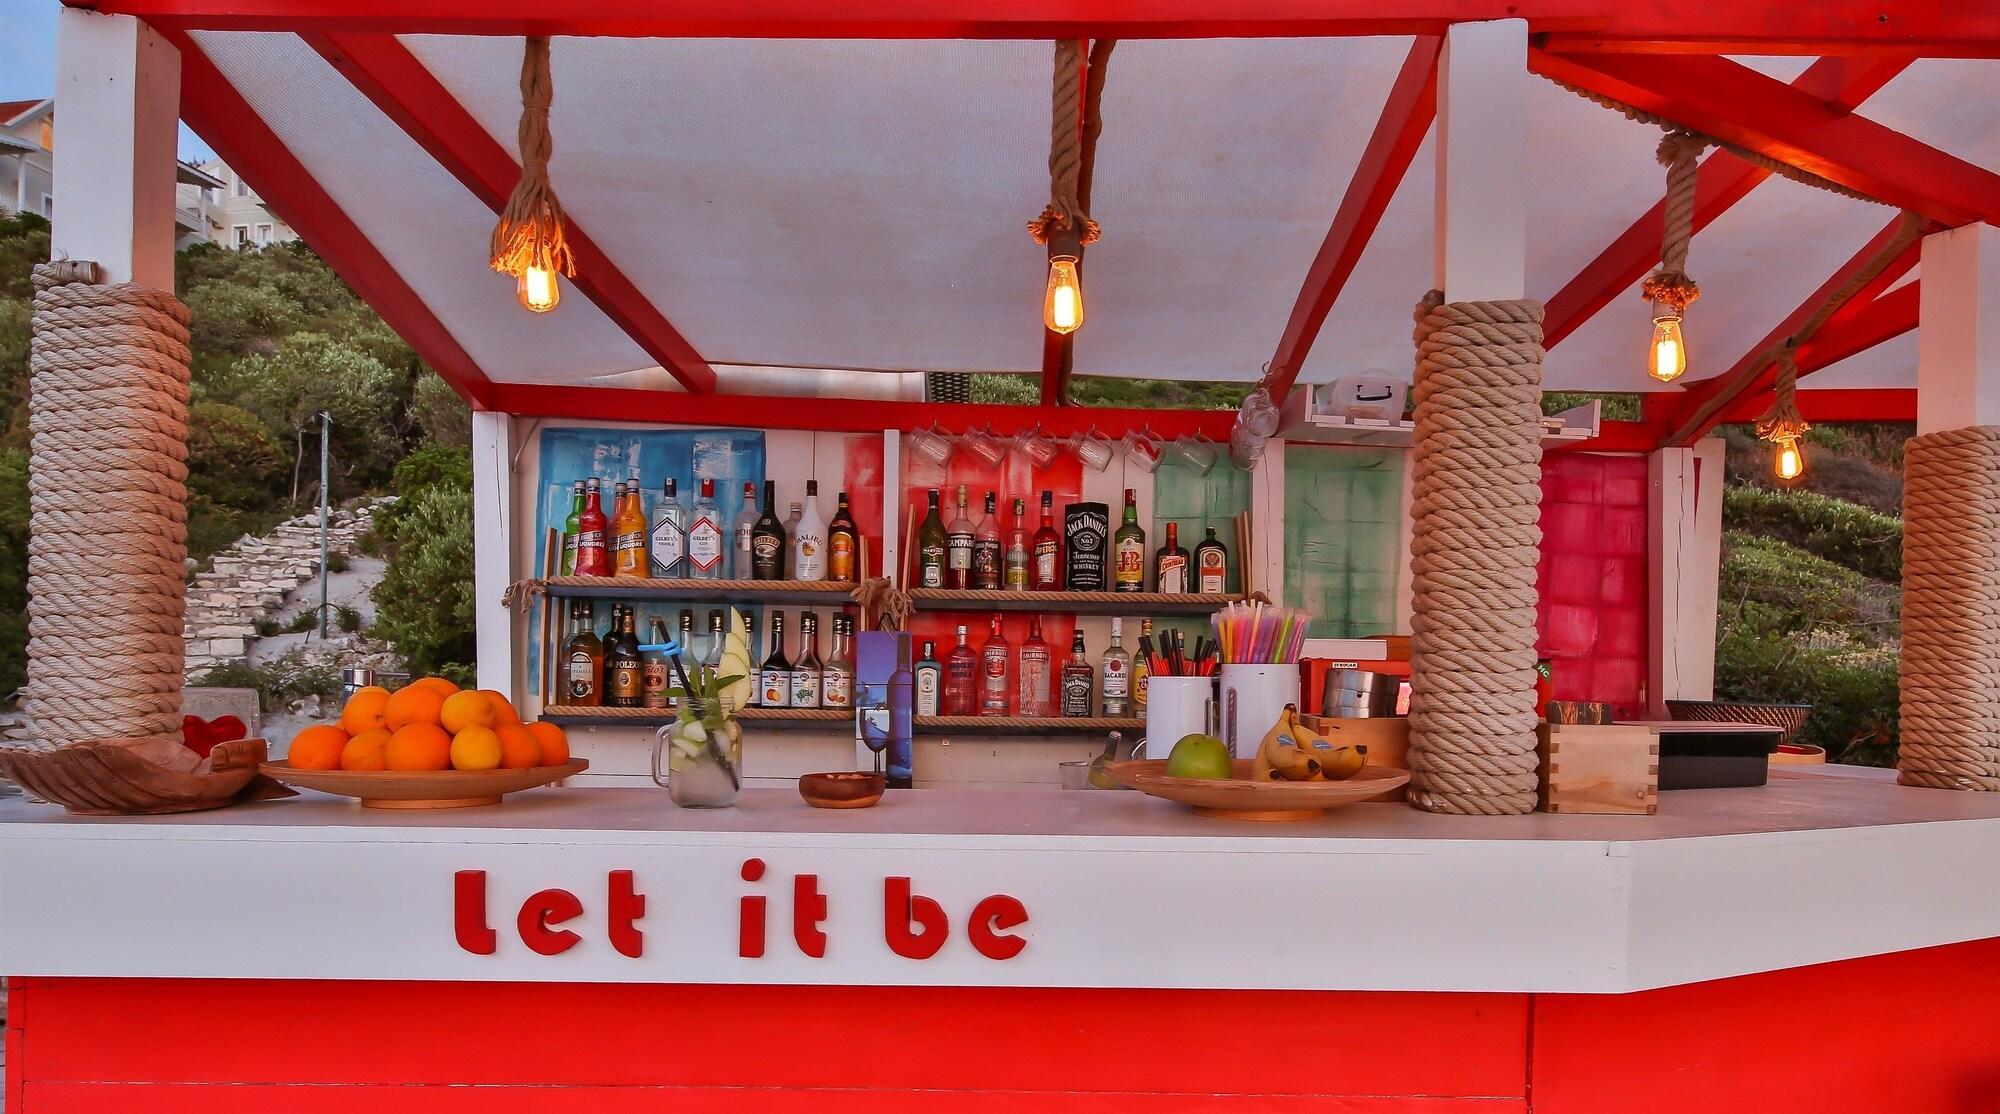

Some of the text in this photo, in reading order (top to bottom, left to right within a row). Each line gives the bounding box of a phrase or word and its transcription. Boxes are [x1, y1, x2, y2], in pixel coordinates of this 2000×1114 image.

[1067, 518, 1084, 537] JACK
[796, 535, 824, 546] MALIBU
[1073, 563, 1100, 571] WHISKEY
[454, 857, 1030, 960] let it be
